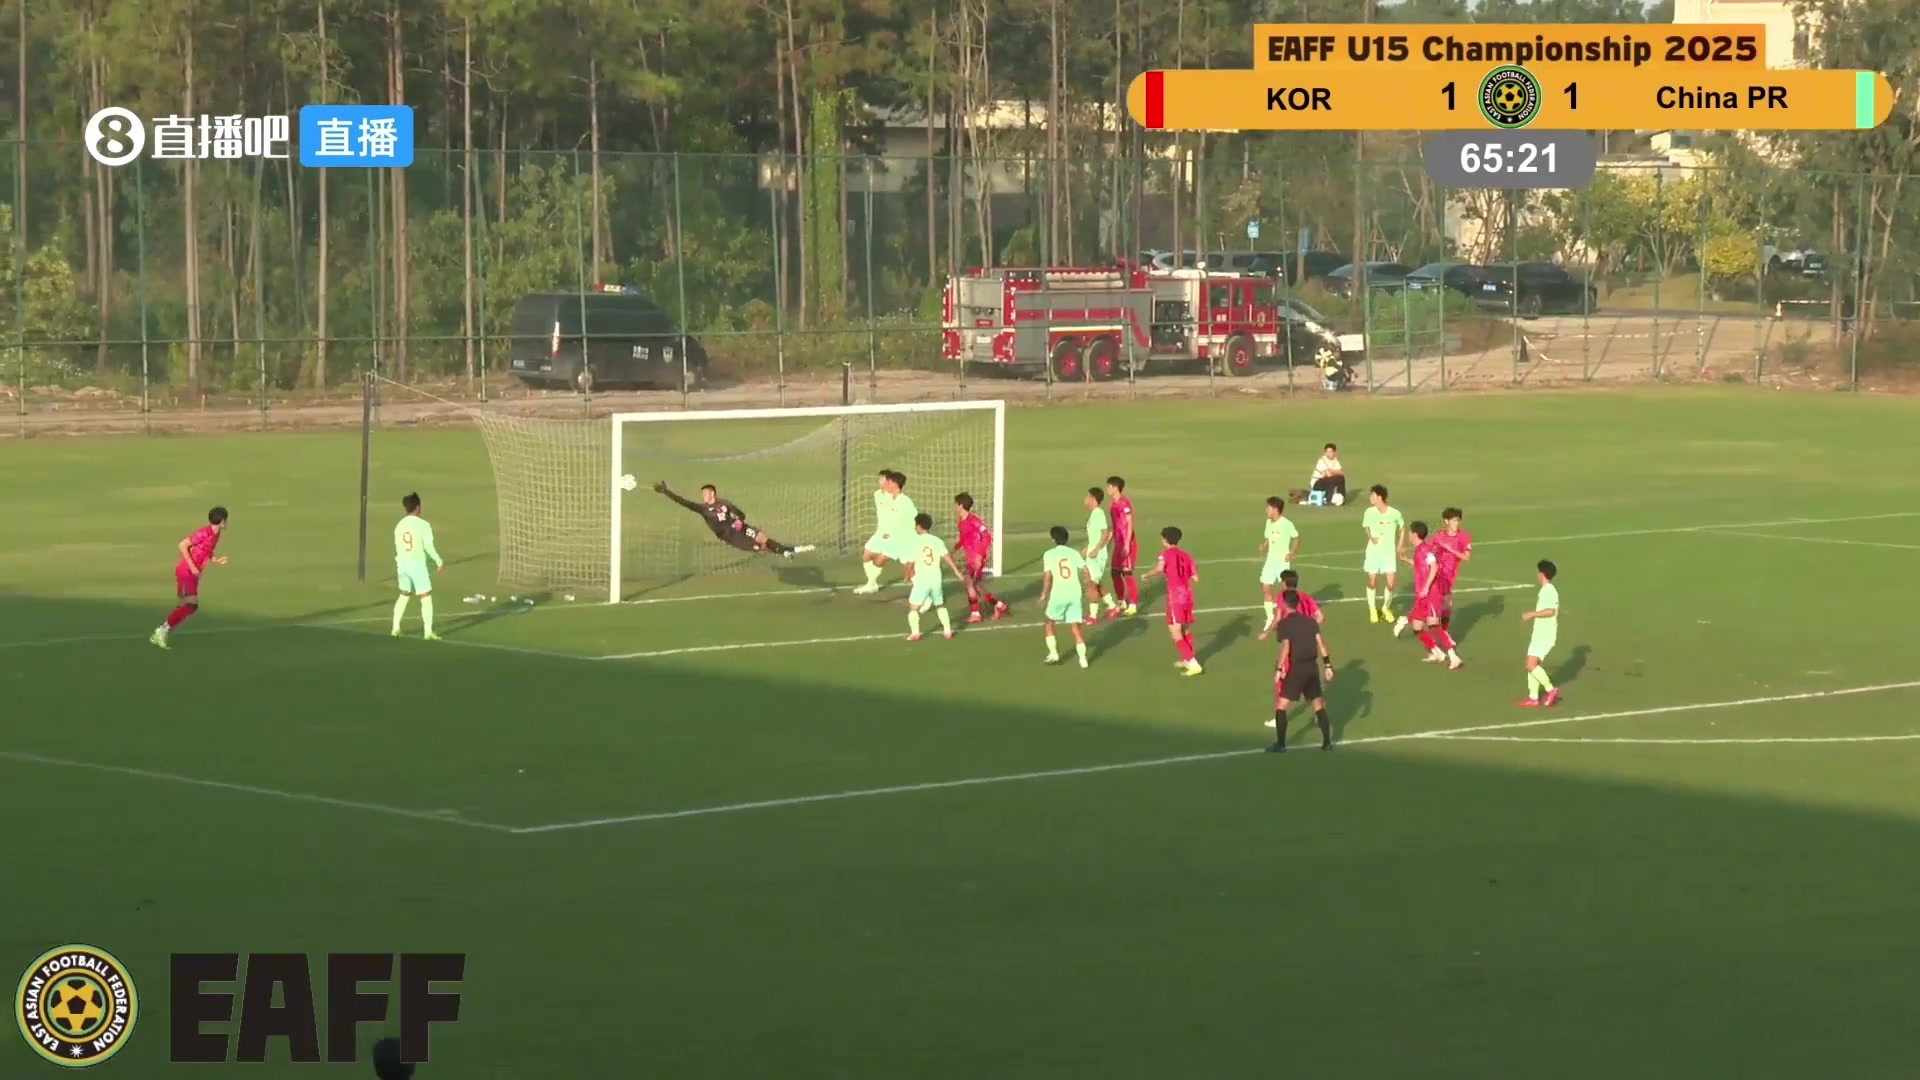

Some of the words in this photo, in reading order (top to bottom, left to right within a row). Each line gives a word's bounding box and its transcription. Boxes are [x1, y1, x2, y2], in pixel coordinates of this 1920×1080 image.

[402, 531, 413, 552] 9
[922, 545, 935, 566] 3
[1058, 558, 1072, 580] 6
